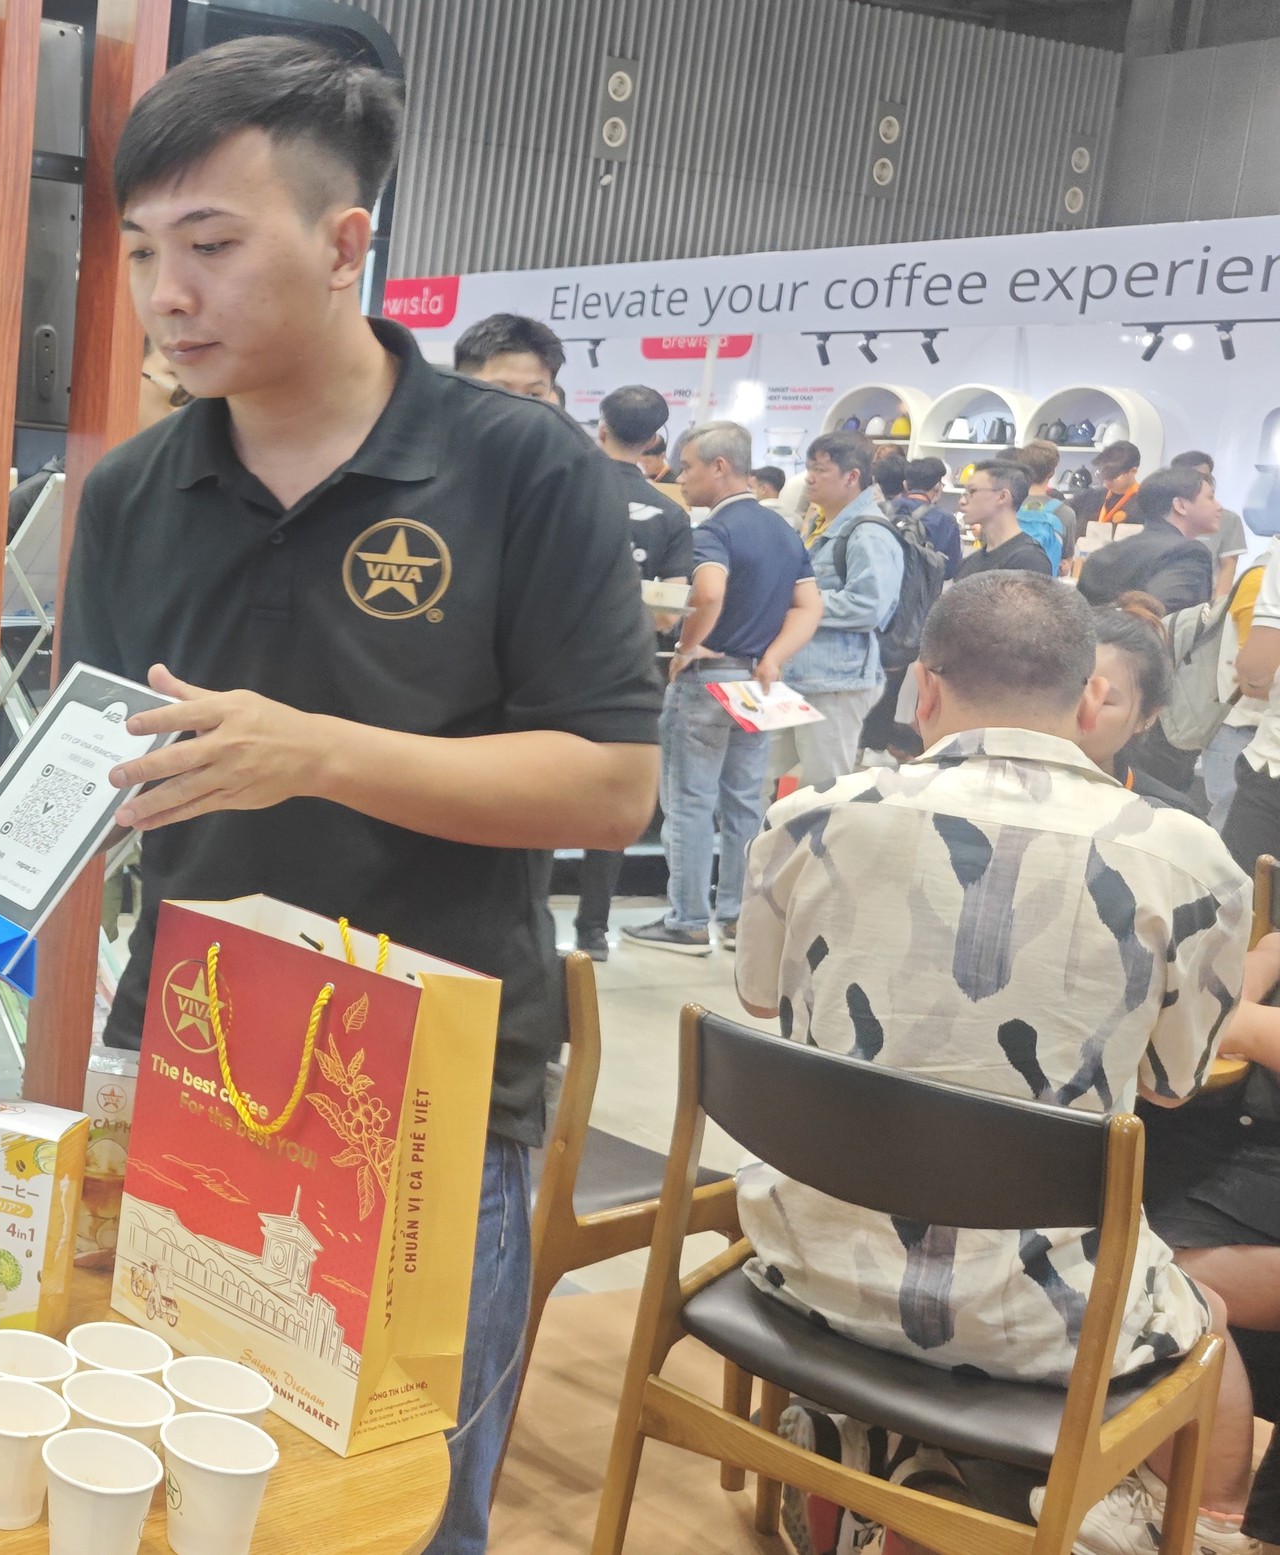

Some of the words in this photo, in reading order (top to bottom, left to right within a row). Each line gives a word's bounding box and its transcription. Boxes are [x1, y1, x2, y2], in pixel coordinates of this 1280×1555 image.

[384, 286, 444, 315] wista
[549, 282, 688, 321] Elevate
[697, 279, 808, 327] your
[823, 261, 987, 310] coffee
[662, 335, 729, 349] brewisa
[365, 561, 423, 583] VIVA
[177, 995, 213, 1020] VIVA
[151, 1054, 179, 1080] The
[182, 1066, 217, 1097] best
[219, 1087, 269, 1120] cfee
[179, 1091, 205, 1114] For
[207, 1106, 233, 1131] the
[236, 1117, 270, 1149] best
[412, 1088, 431, 1124] VIỆT
[114, 1121, 131, 1134] PH
[409, 1132, 426, 1163] PHÊ
[407, 1170, 423, 1190] CÀ
[6, 1223, 35, 1242] 4in1
[400, 1220, 419, 1273] CHUẨN
[269, 1381, 295, 1403] ANH
[297, 1399, 340, 1431] MARKET
